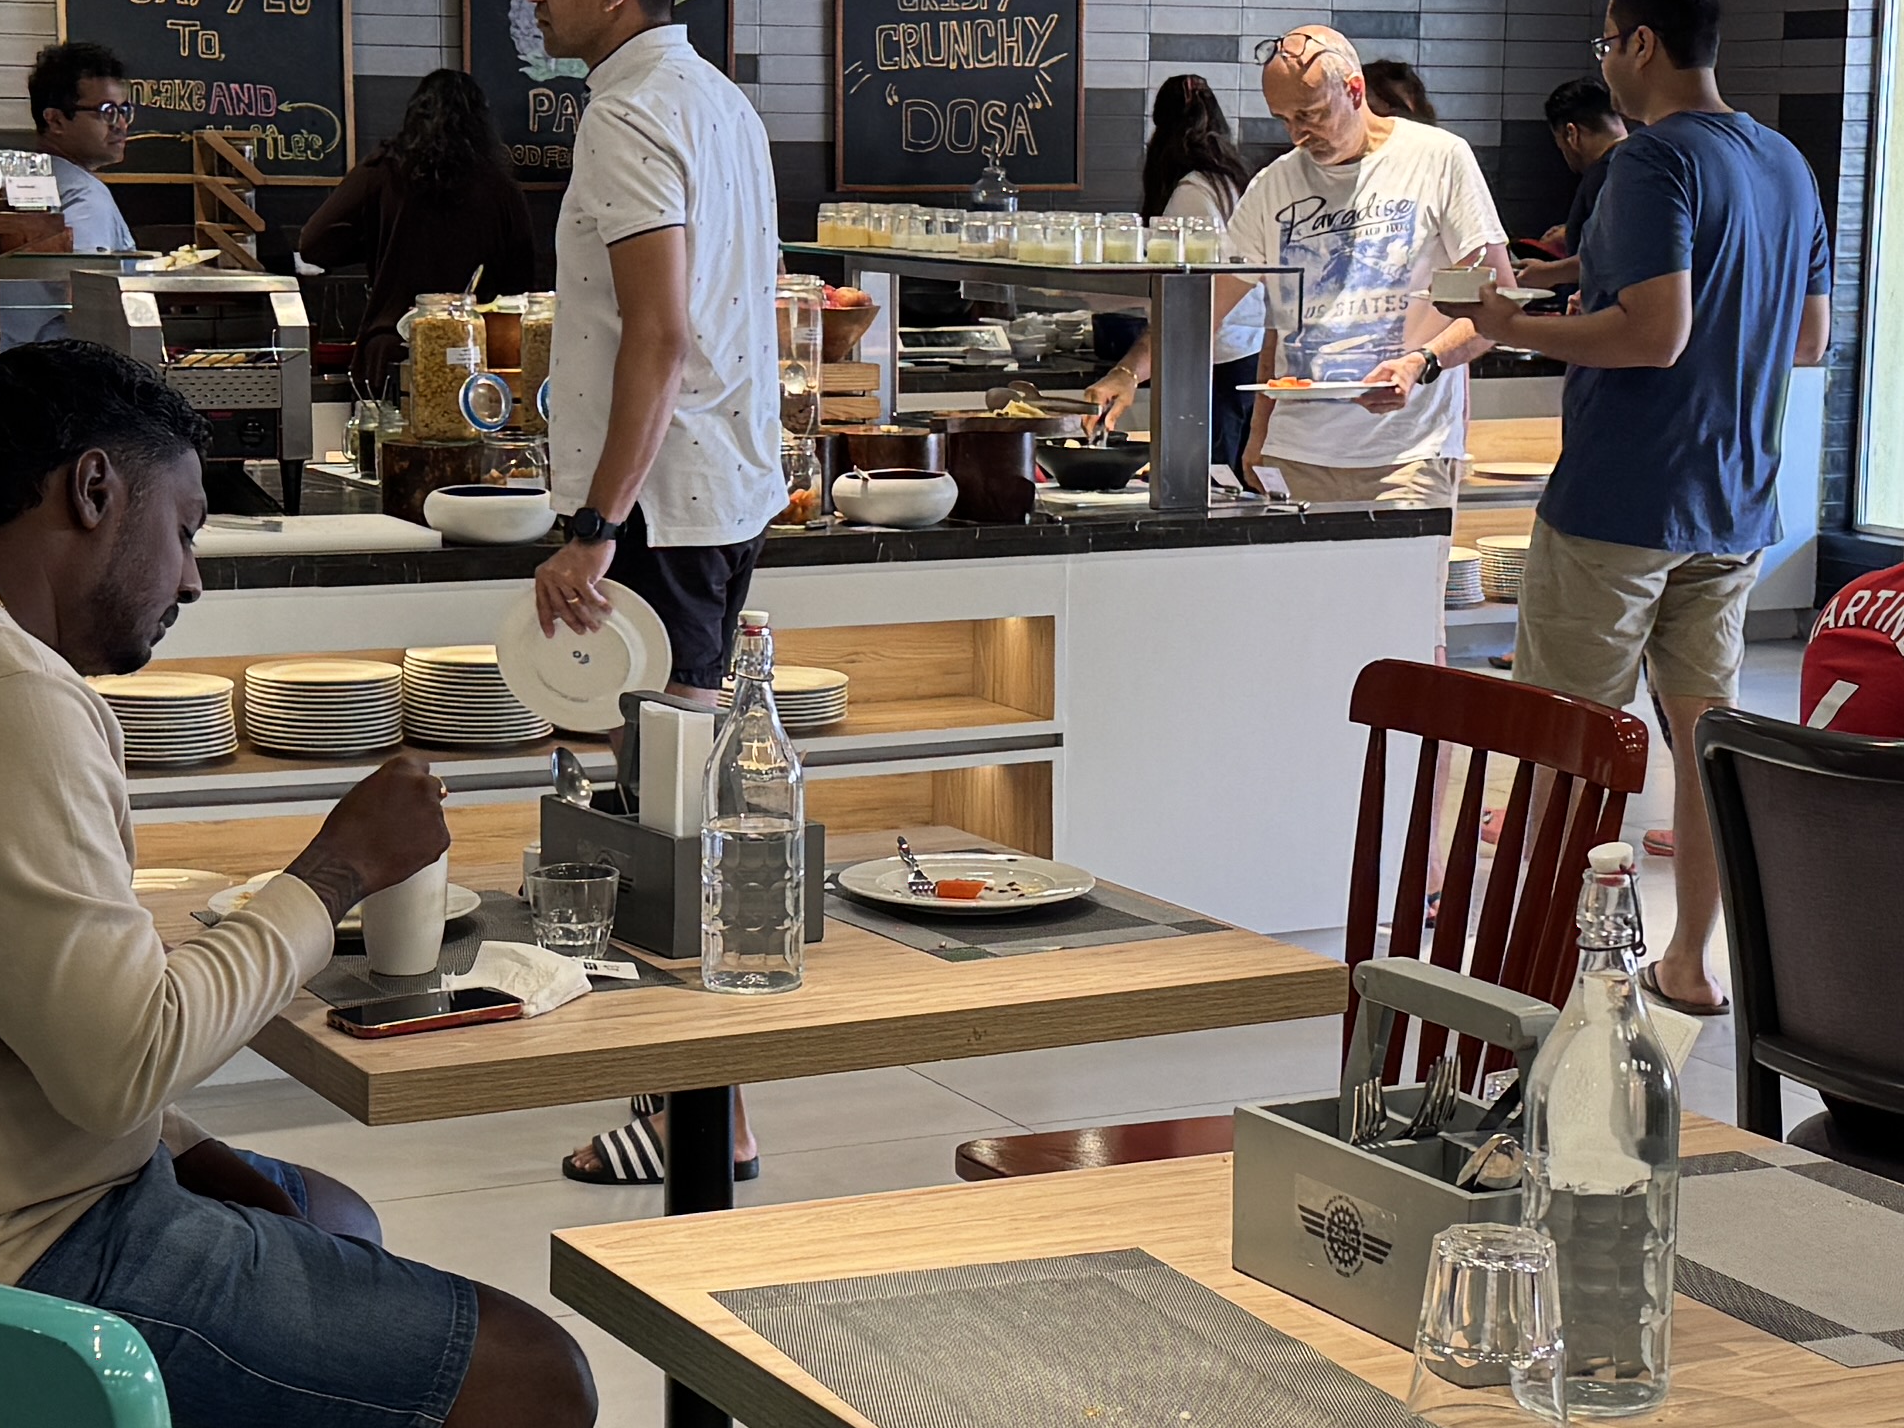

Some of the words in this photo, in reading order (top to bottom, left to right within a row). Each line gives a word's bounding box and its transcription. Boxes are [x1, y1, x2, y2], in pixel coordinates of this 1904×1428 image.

[876, 14, 1059, 70] CRUNCHY
[208, 81, 278, 117] AND
[1275, 192, 1415, 244] Paradise
